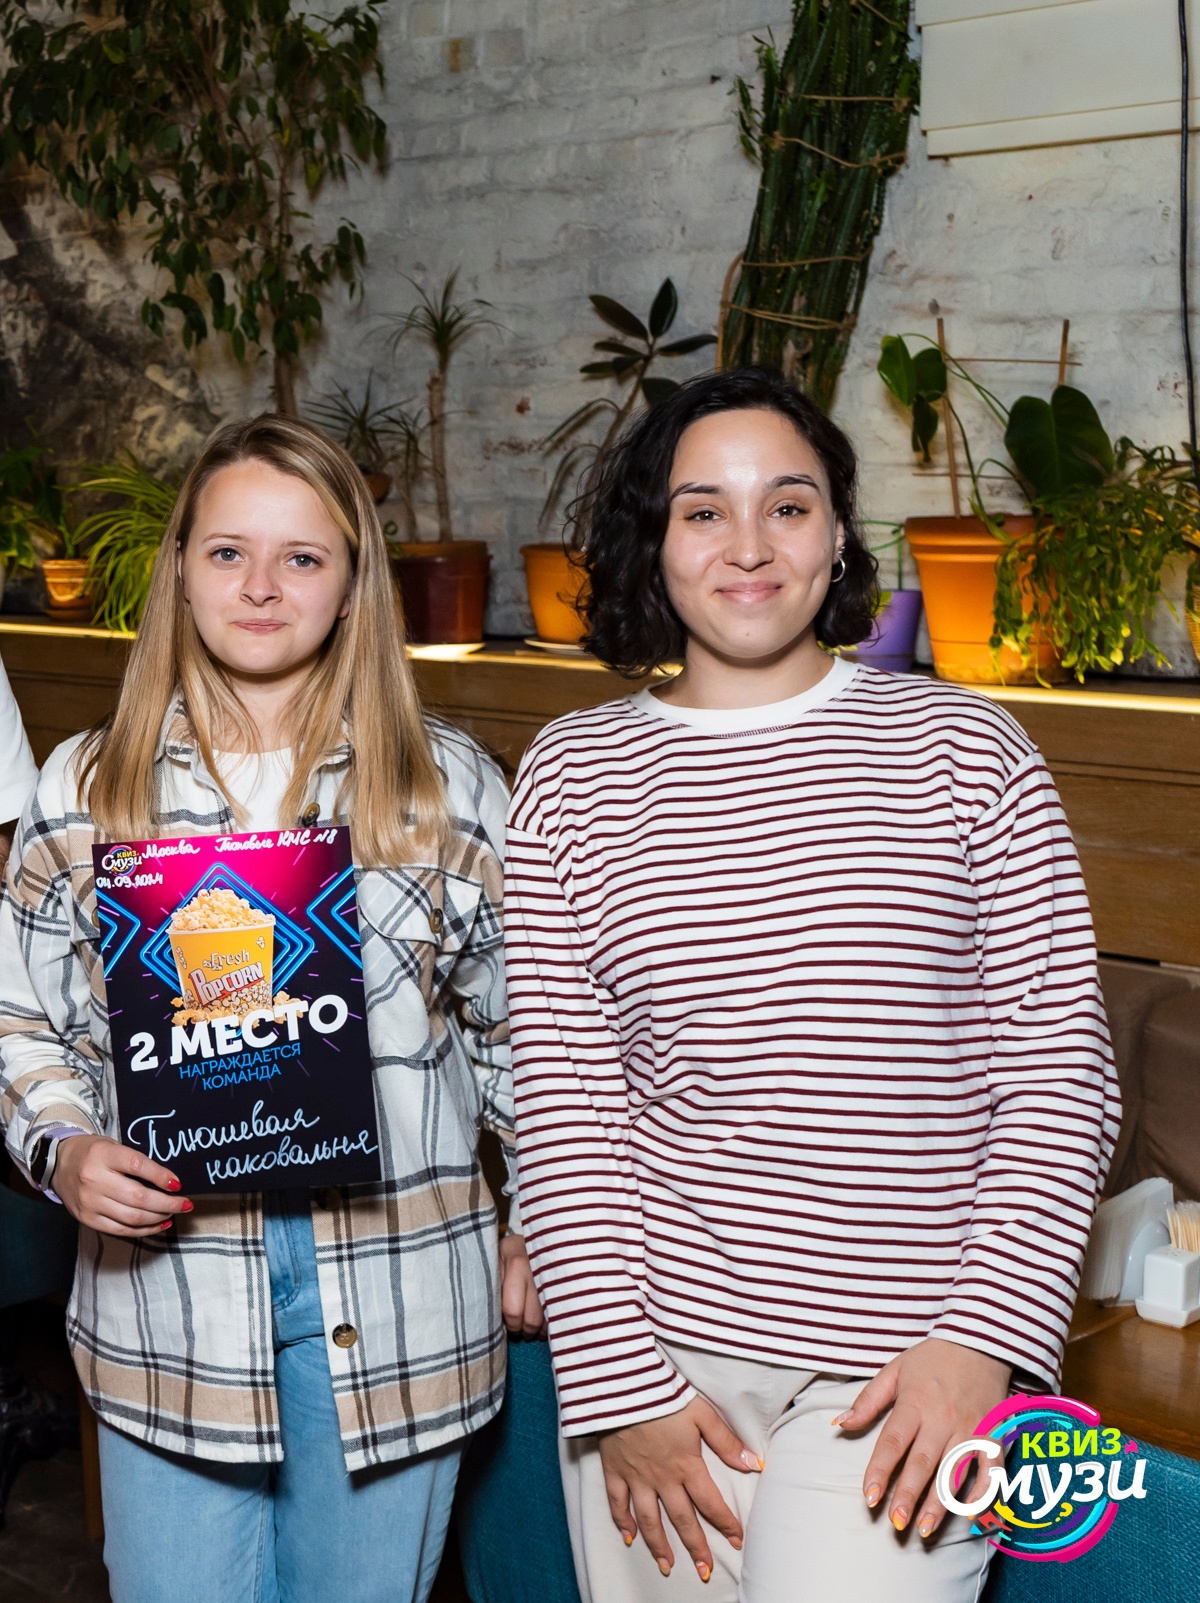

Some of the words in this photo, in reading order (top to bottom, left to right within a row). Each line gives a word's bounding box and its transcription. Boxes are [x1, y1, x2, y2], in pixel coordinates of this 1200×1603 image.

[101, 855, 142, 870] Смузи
[117, 850, 137, 859] КВИЗ
[142, 839, 200, 859] Москва
[211, 949, 250, 967] Fresh
[129, 1032, 159, 1072] 2
[170, 994, 348, 1066] МЕСТО
[179, 1042, 301, 1080] НАГРАЖДАЕТСЯ
[202, 1064, 282, 1091] КОМАНДА
[127, 1099, 321, 1162] Плюшевая
[206, 1129, 378, 1185] наковальня
